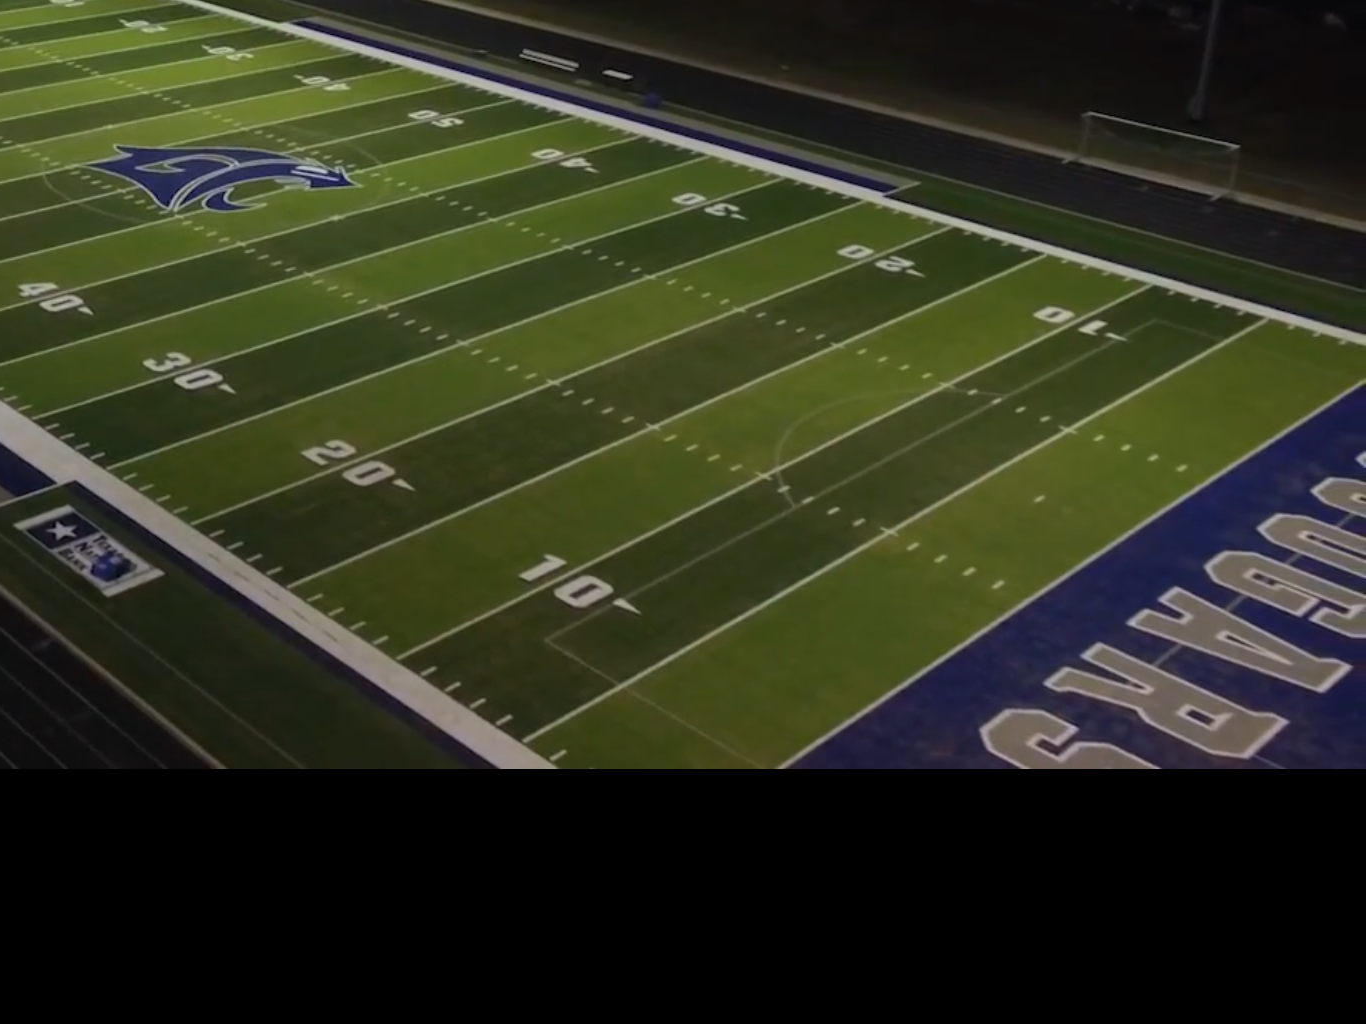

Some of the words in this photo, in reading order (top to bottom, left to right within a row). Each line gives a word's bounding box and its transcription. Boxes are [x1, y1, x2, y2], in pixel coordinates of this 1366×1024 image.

[408, 110, 464, 128] 50
[531, 149, 591, 168] 40
[672, 193, 739, 217] 30
[837, 245, 915, 272] 20
[18, 282, 84, 312] 40
[1033, 307, 1108, 336] 10
[143, 352, 223, 390] 30
[301, 440, 395, 486] 20
[520, 554, 615, 608] 10
